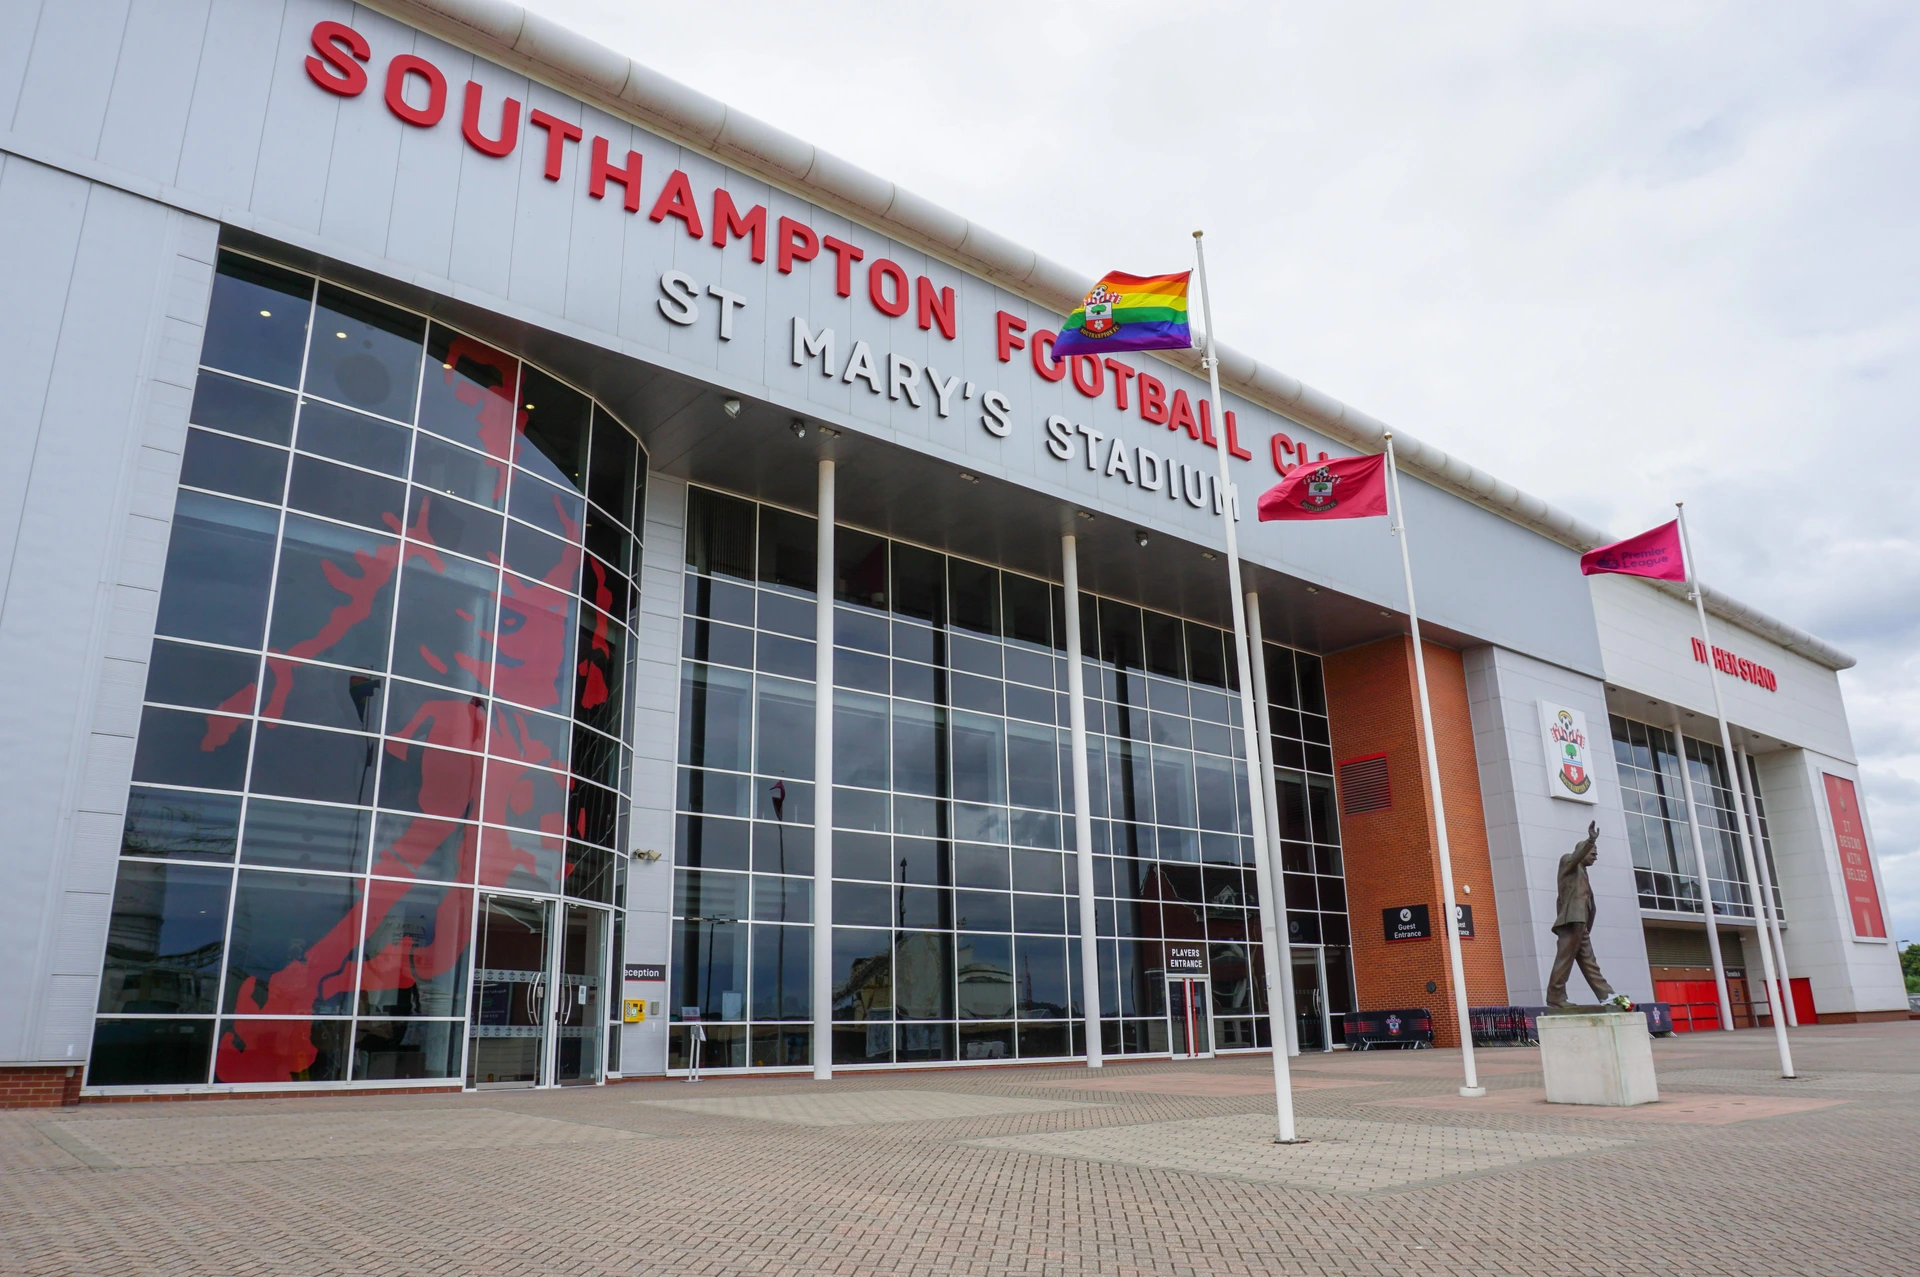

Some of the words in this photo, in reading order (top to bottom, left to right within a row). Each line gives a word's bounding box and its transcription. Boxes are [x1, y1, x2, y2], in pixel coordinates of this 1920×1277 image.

[304, 20, 956, 341] SOUTHAMPTON
[997, 310, 1252, 461] FOOTBALL
[657, 270, 746, 342] ST
[792, 316, 1012, 438] MARY'S
[1047, 414, 1240, 522] STADIUM
[1621, 547, 1667, 560] Premier
[1623, 556, 1669, 569] League
[1691, 636, 1740, 678] ITHEN
[1738, 657, 1778, 692] STAND
[1842, 820, 1851, 833] IT
[1839, 834, 1862, 850] BEGINS
[1846, 851, 1862, 866] WITH
[1845, 867, 1868, 882] BELIEF
[1398, 923, 1416, 931] Guest
[1394, 931, 1422, 939] Entrance
[1171, 948, 1200, 957] PLAYERS
[1170, 959, 1203, 968] ENTRANCE
[624, 968, 660, 978] eception
